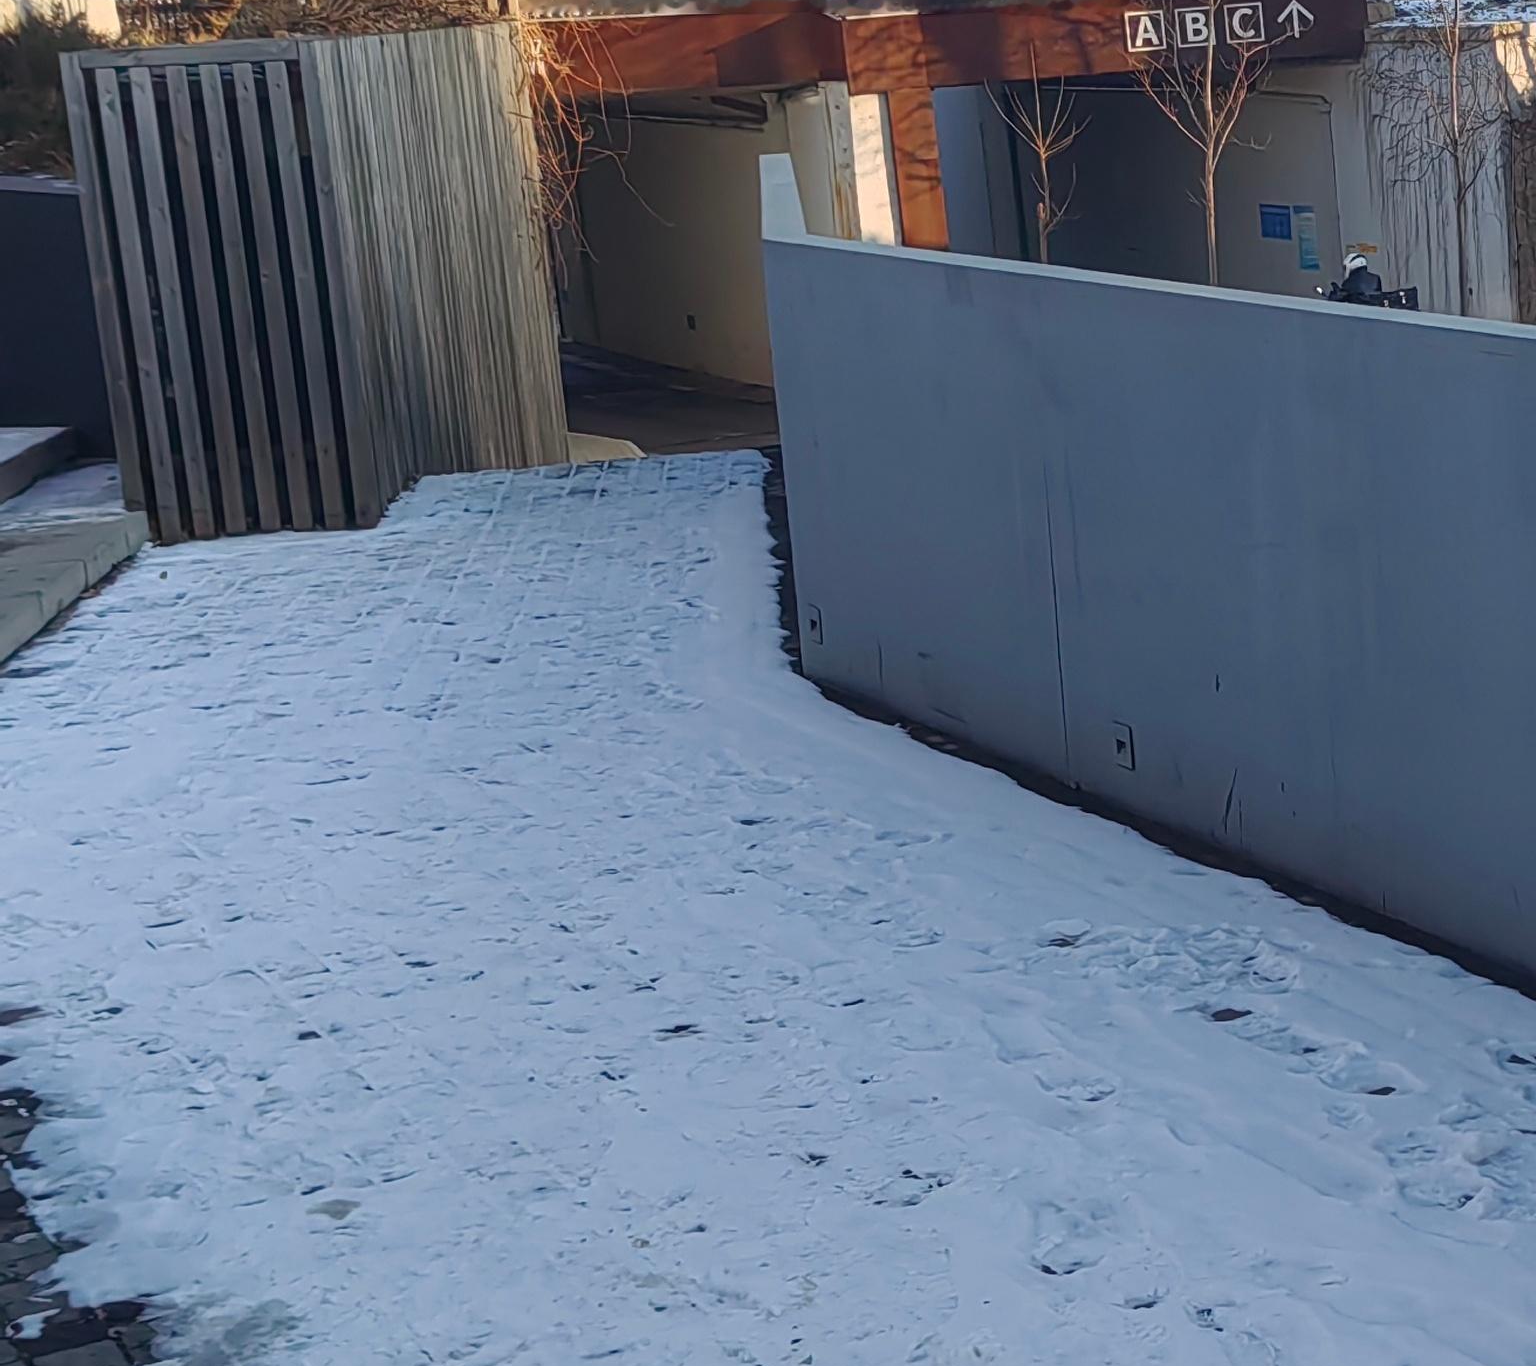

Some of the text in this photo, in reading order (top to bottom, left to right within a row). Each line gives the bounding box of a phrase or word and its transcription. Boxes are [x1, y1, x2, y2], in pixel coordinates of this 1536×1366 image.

[1135, 7, 1256, 47] A B C
